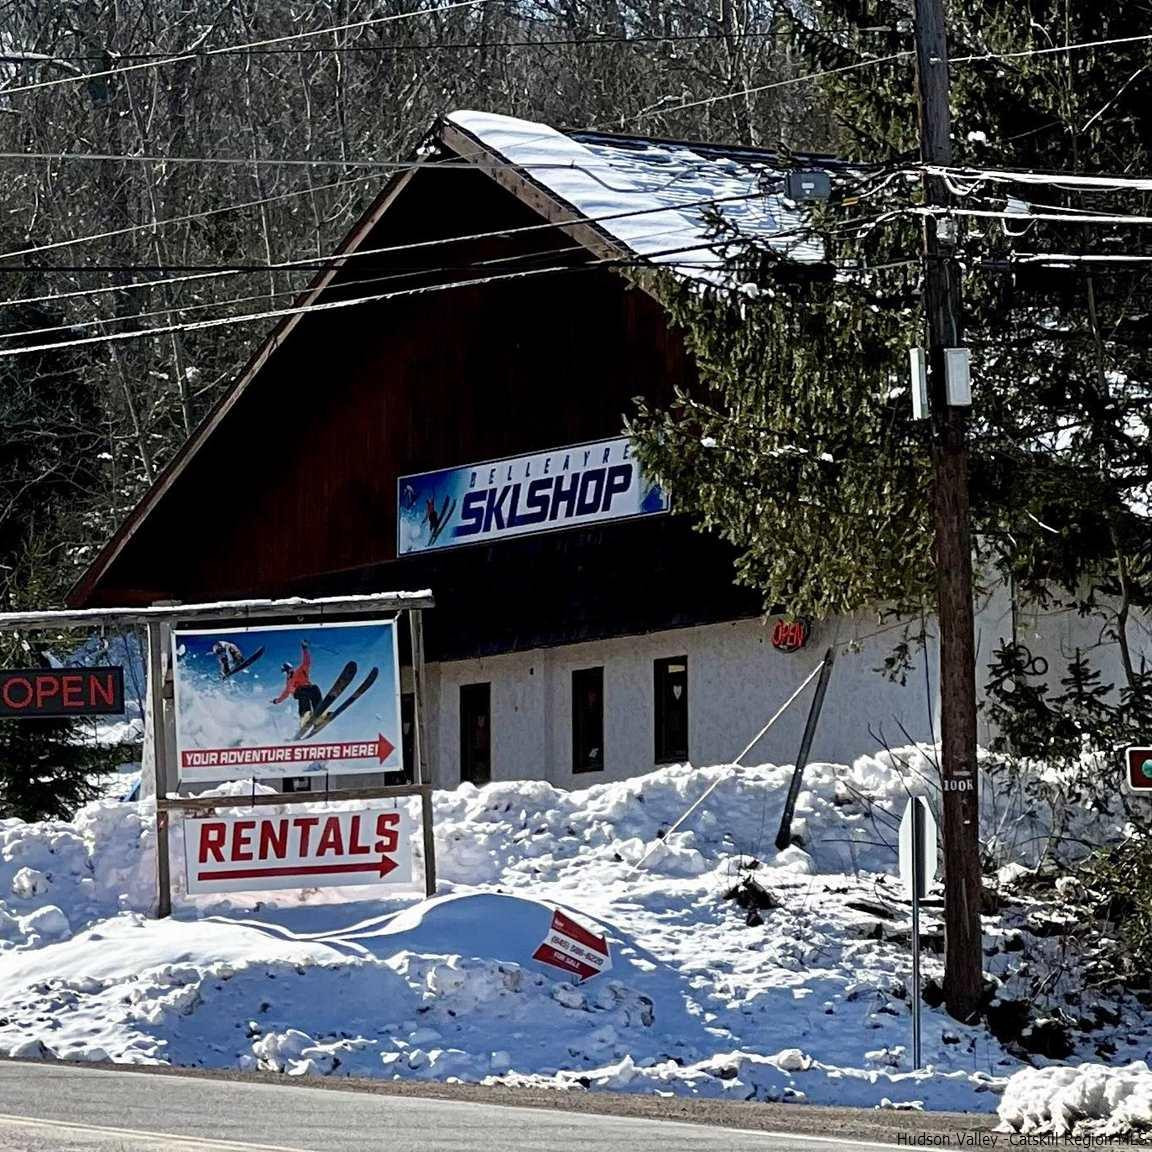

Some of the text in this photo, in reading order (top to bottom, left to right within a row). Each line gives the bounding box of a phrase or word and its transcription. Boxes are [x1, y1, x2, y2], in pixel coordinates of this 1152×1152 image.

[469, 444, 632, 488] BELLEAYRE
[772, 621, 804, 647] OPEN
[2, 674, 115, 708] OPEN
[185, 744, 378, 766] YOUR ADVENTURE STARTS HERE!
[198, 813, 401, 864] RENTALS
[553, 951, 581, 968] FOR SALE
